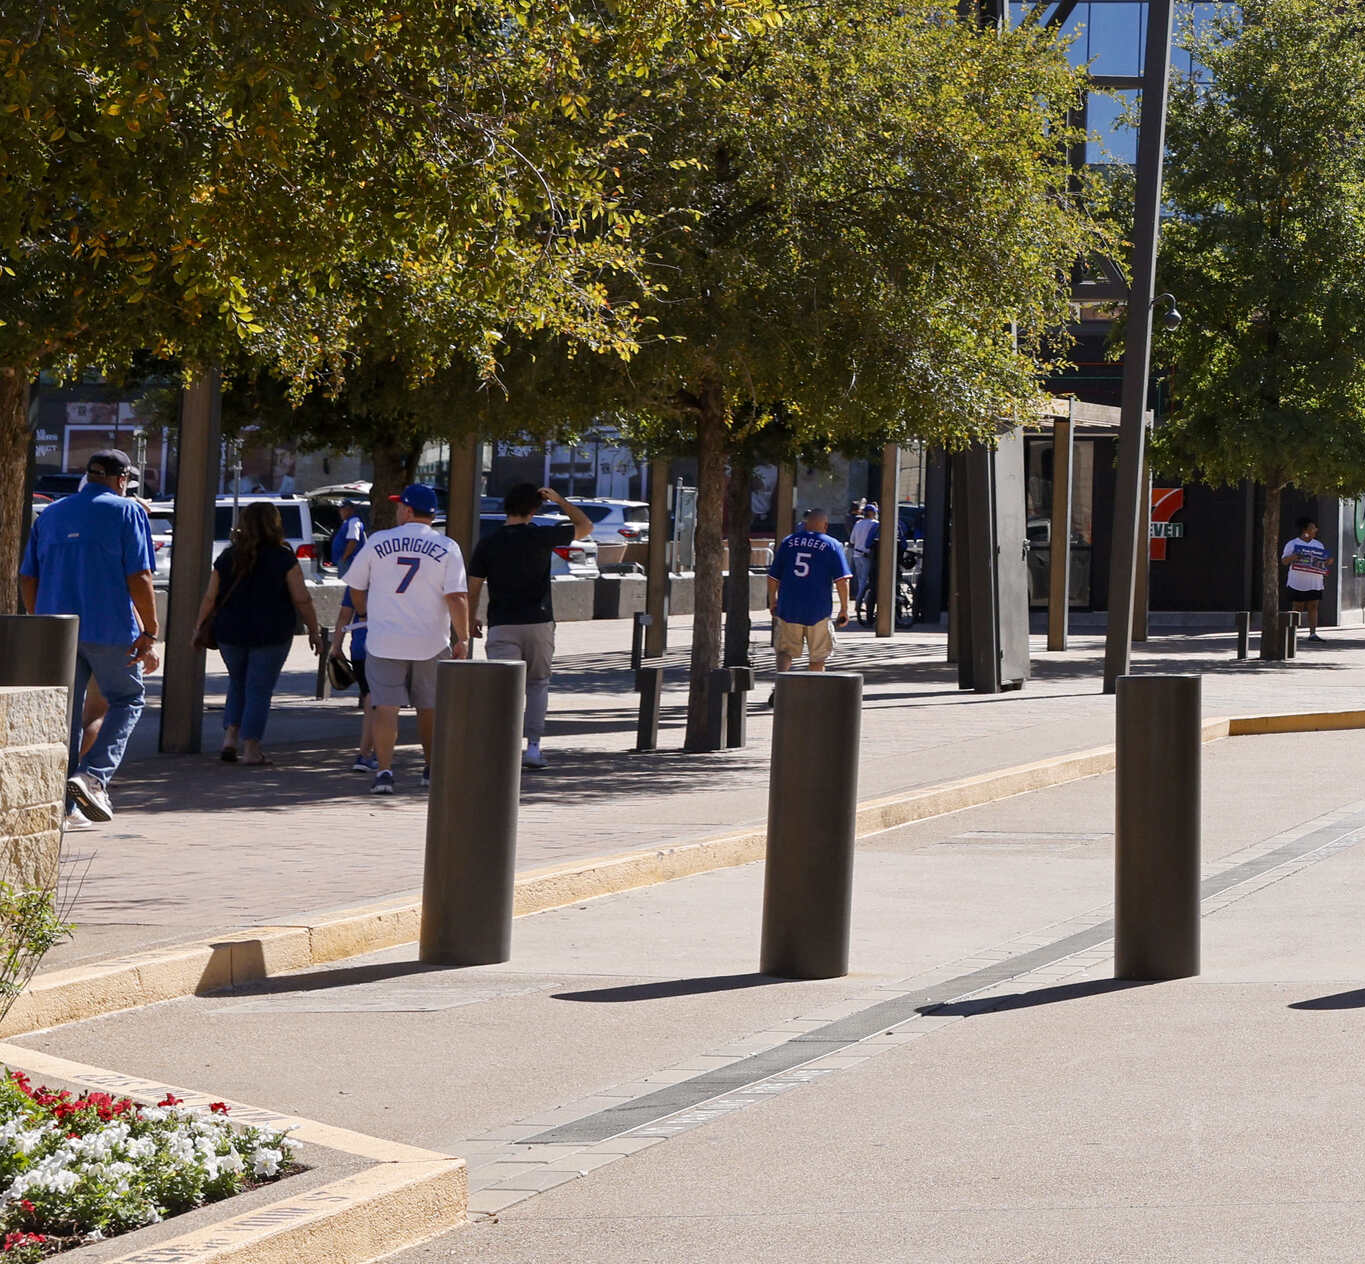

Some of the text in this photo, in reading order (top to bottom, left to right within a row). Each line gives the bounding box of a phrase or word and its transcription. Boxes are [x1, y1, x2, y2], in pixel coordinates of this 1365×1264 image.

[374, 537, 448, 563] RODRIGUEZ
[787, 537, 827, 551] SEAGER
[395, 556, 421, 593] 7
[793, 552, 812, 577] 5
